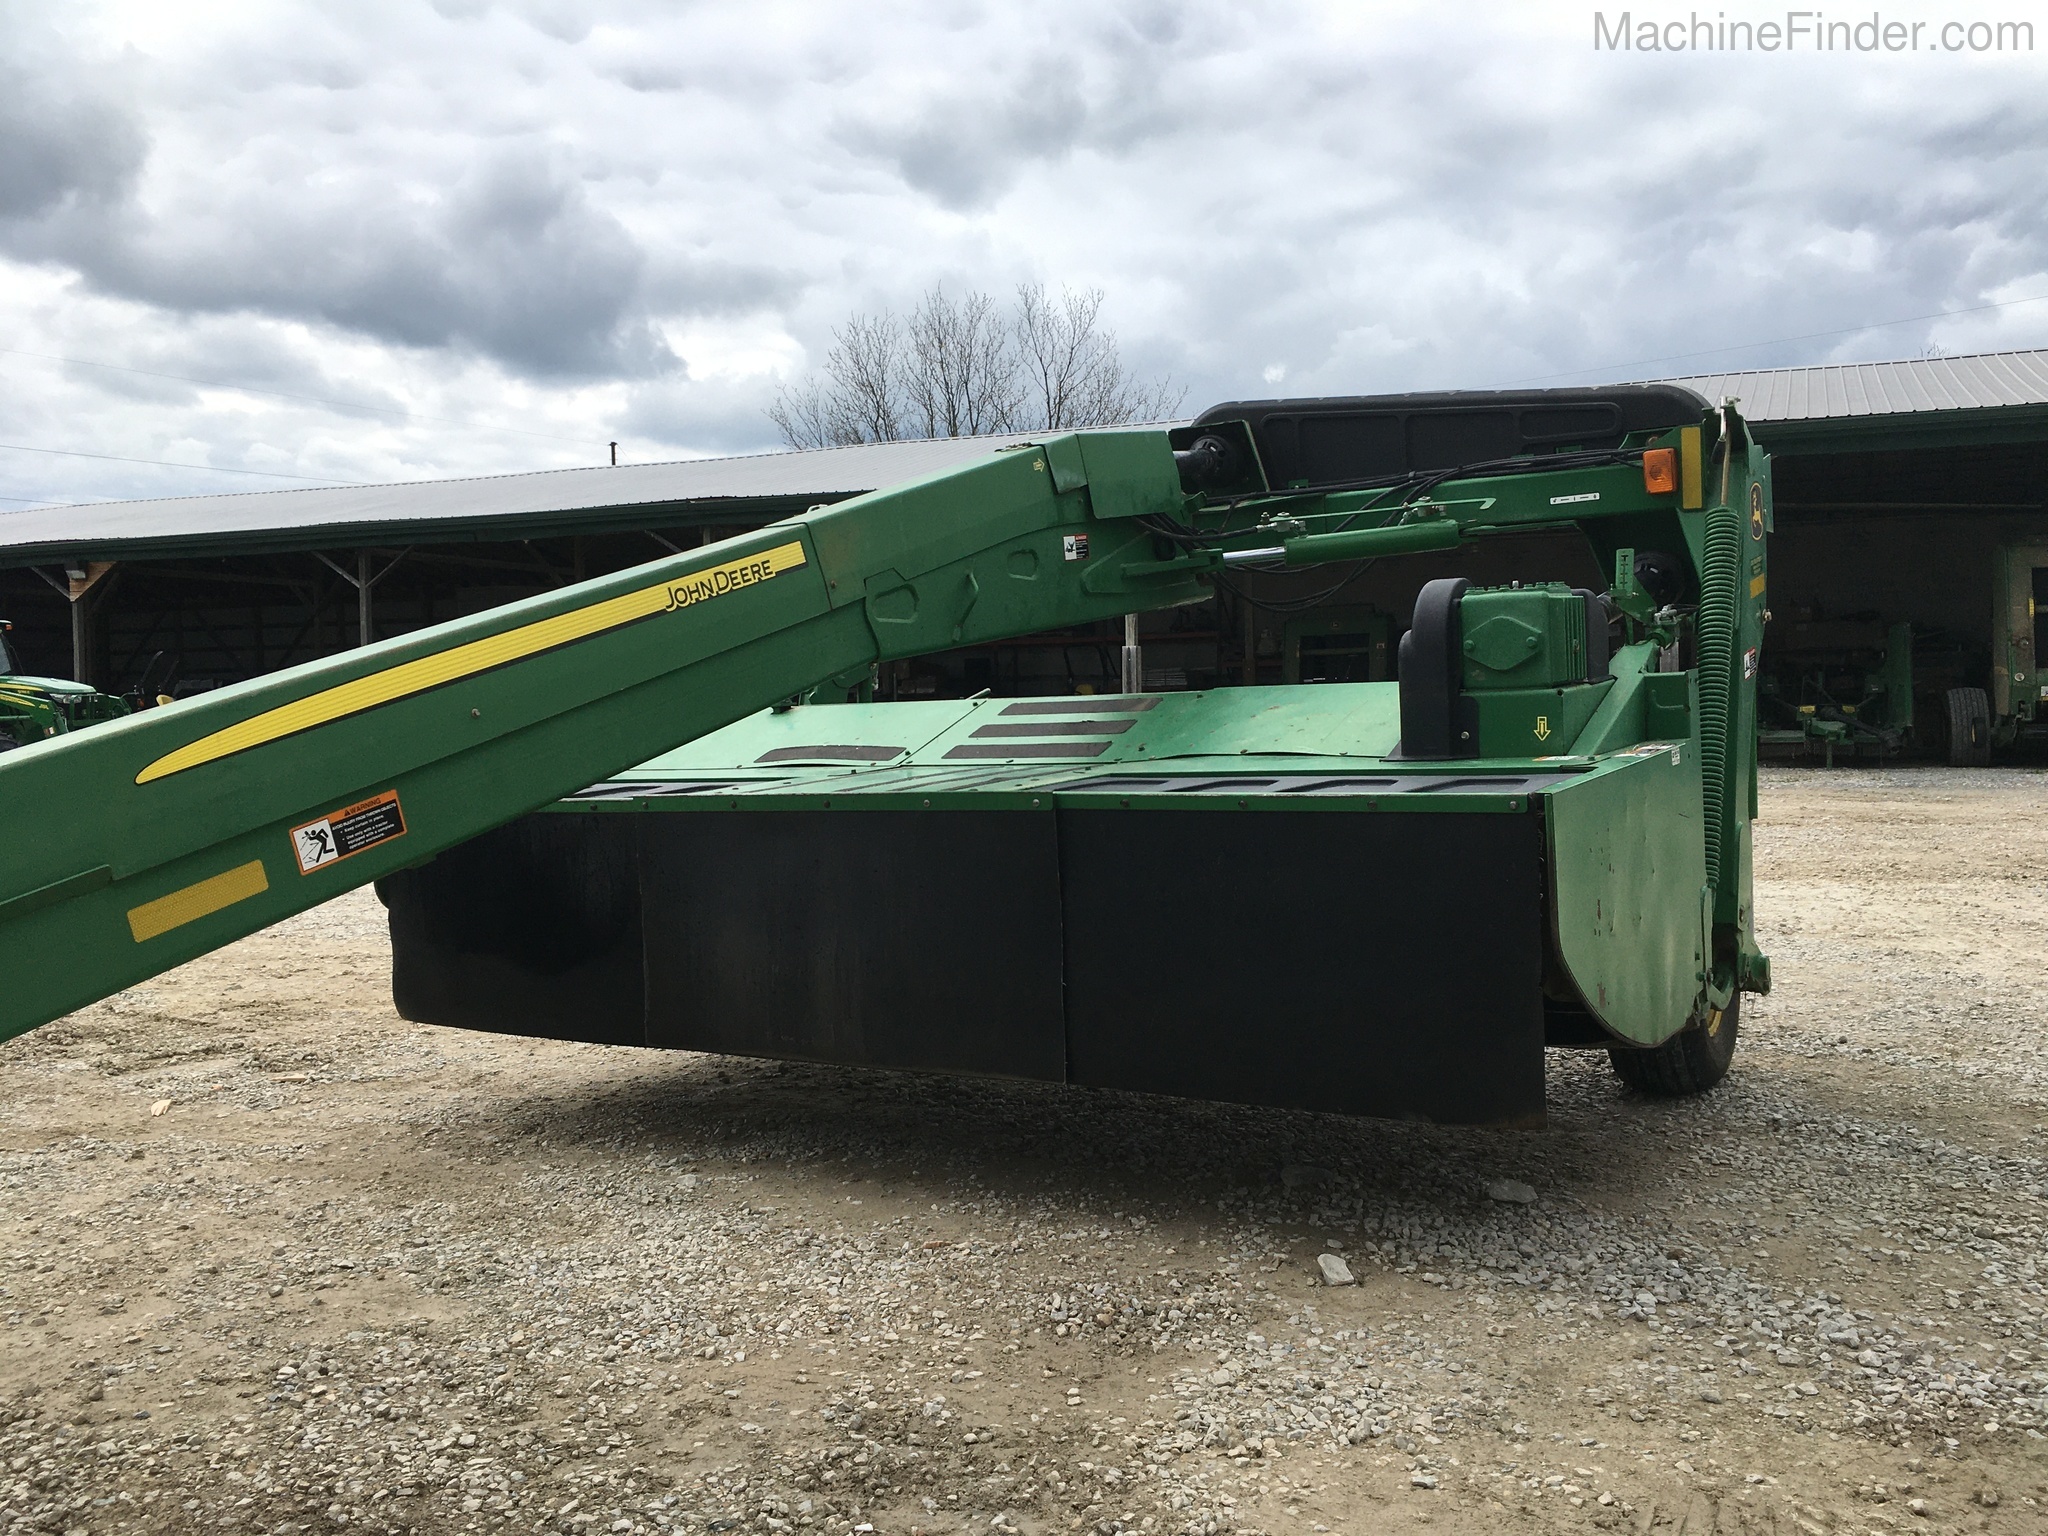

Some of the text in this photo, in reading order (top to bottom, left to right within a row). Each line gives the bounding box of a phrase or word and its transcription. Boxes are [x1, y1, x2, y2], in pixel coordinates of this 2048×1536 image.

[350, 798, 381, 813] WARNING
[366, 809, 381, 817] THROWN
[381, 803, 396, 811] OBJECTS
